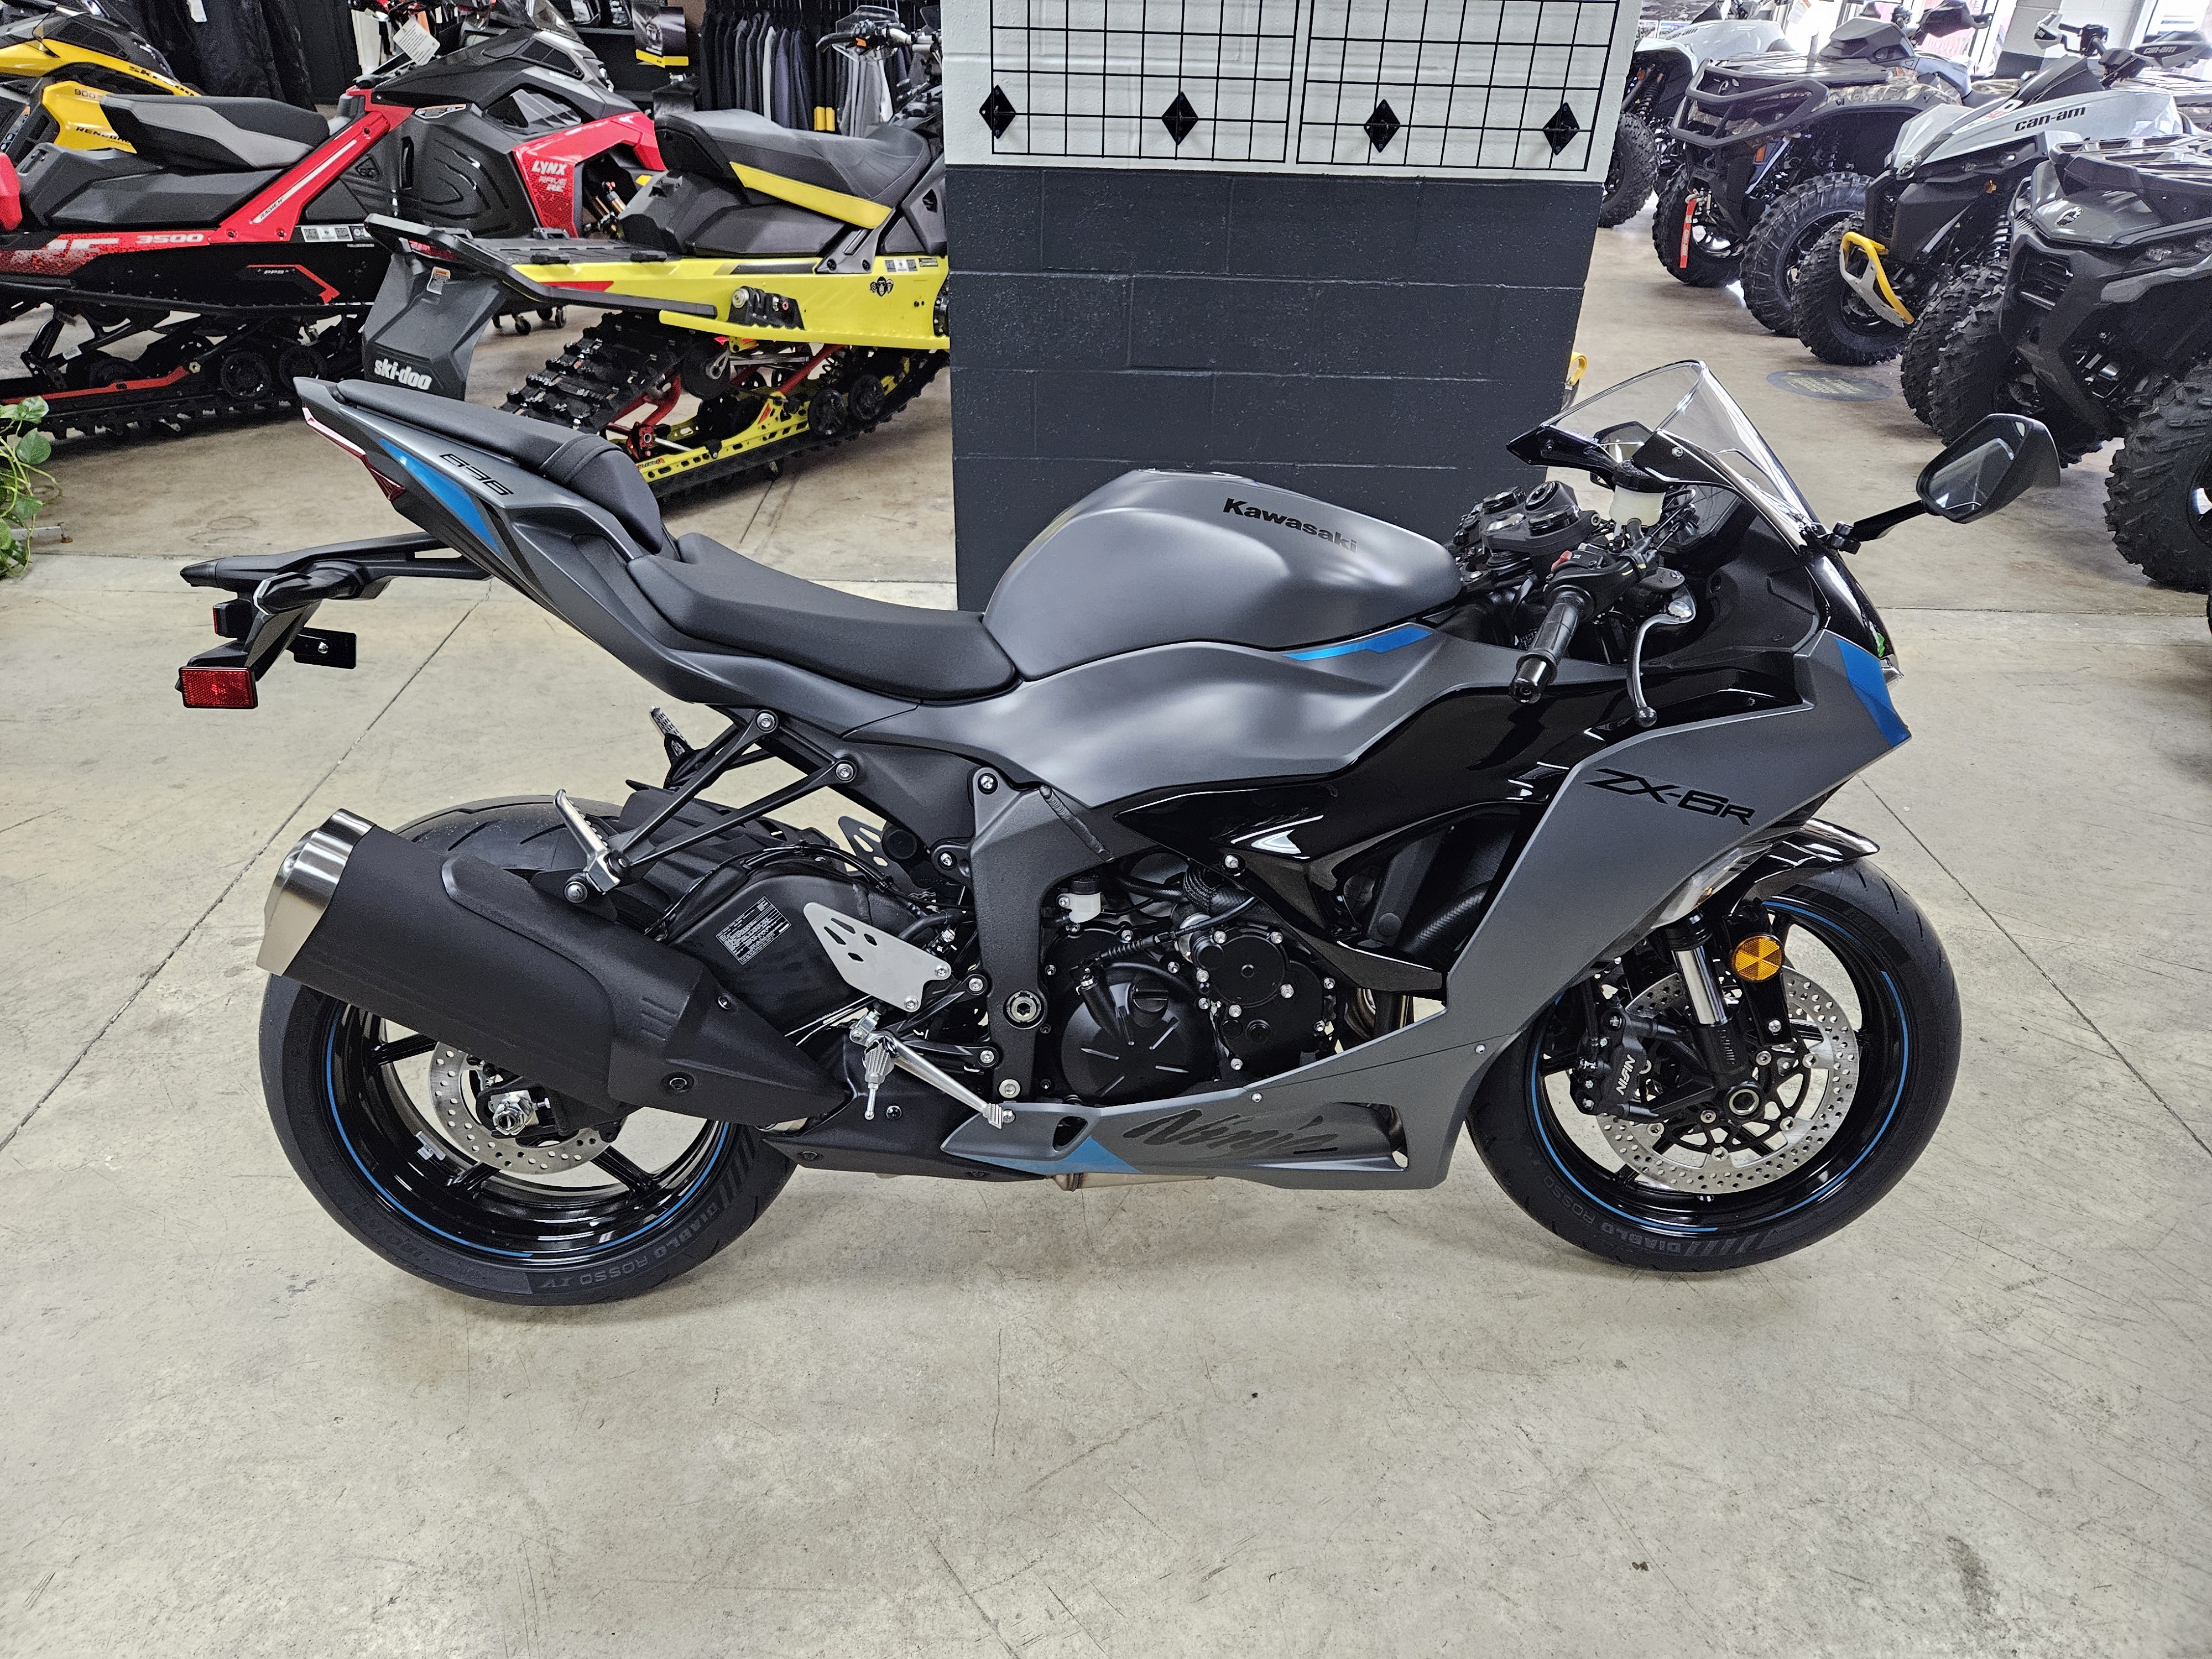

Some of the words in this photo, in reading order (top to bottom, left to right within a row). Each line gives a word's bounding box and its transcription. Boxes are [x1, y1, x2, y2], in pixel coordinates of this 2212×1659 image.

[2015, 107, 2086, 132] can-am
[531, 160, 567, 176] LYNX
[539, 176, 567, 189] RAVE
[135, 233, 205, 244] 3500
[374, 358, 432, 390] ski-doo
[439, 453, 514, 495] 636
[1222, 498, 1357, 554] Kawasaki
[1584, 768, 1755, 827] ZX-6R
[1122, 1108, 1339, 1160] Ninja
[1543, 1176, 1595, 1224] ROSSO
[654, 1202, 718, 1259] DIABLO
[1601, 1222, 1681, 1253] DIABLO
[580, 1255, 649, 1285] ROSSO
